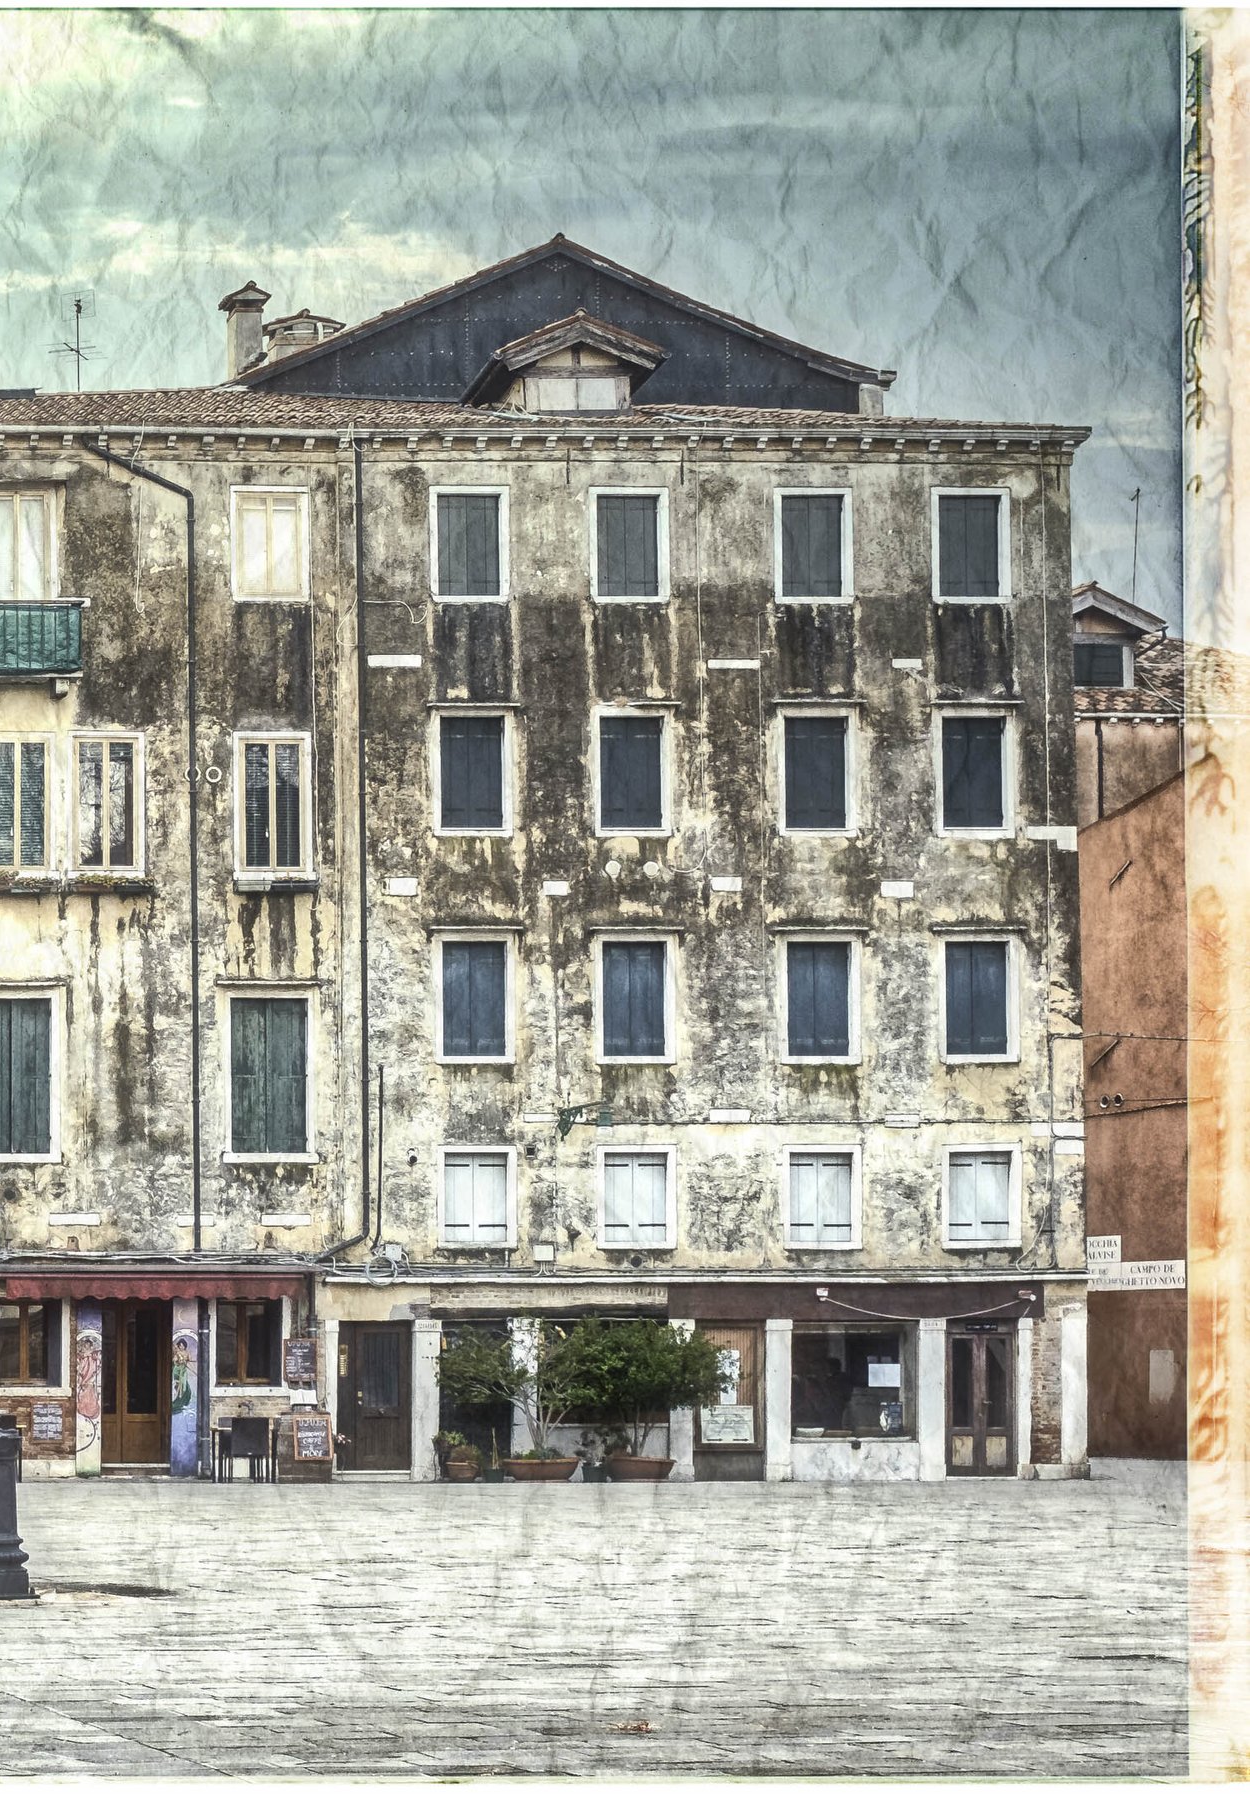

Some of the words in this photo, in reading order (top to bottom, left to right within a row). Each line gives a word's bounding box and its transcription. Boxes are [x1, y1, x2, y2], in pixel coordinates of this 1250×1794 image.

[1130, 1265, 1161, 1274] CAMPO
[1163, 1264, 1175, 1273] DE
[1121, 1277, 1157, 1286] GHETTO
[1159, 1275, 1185, 1285] NOVO
